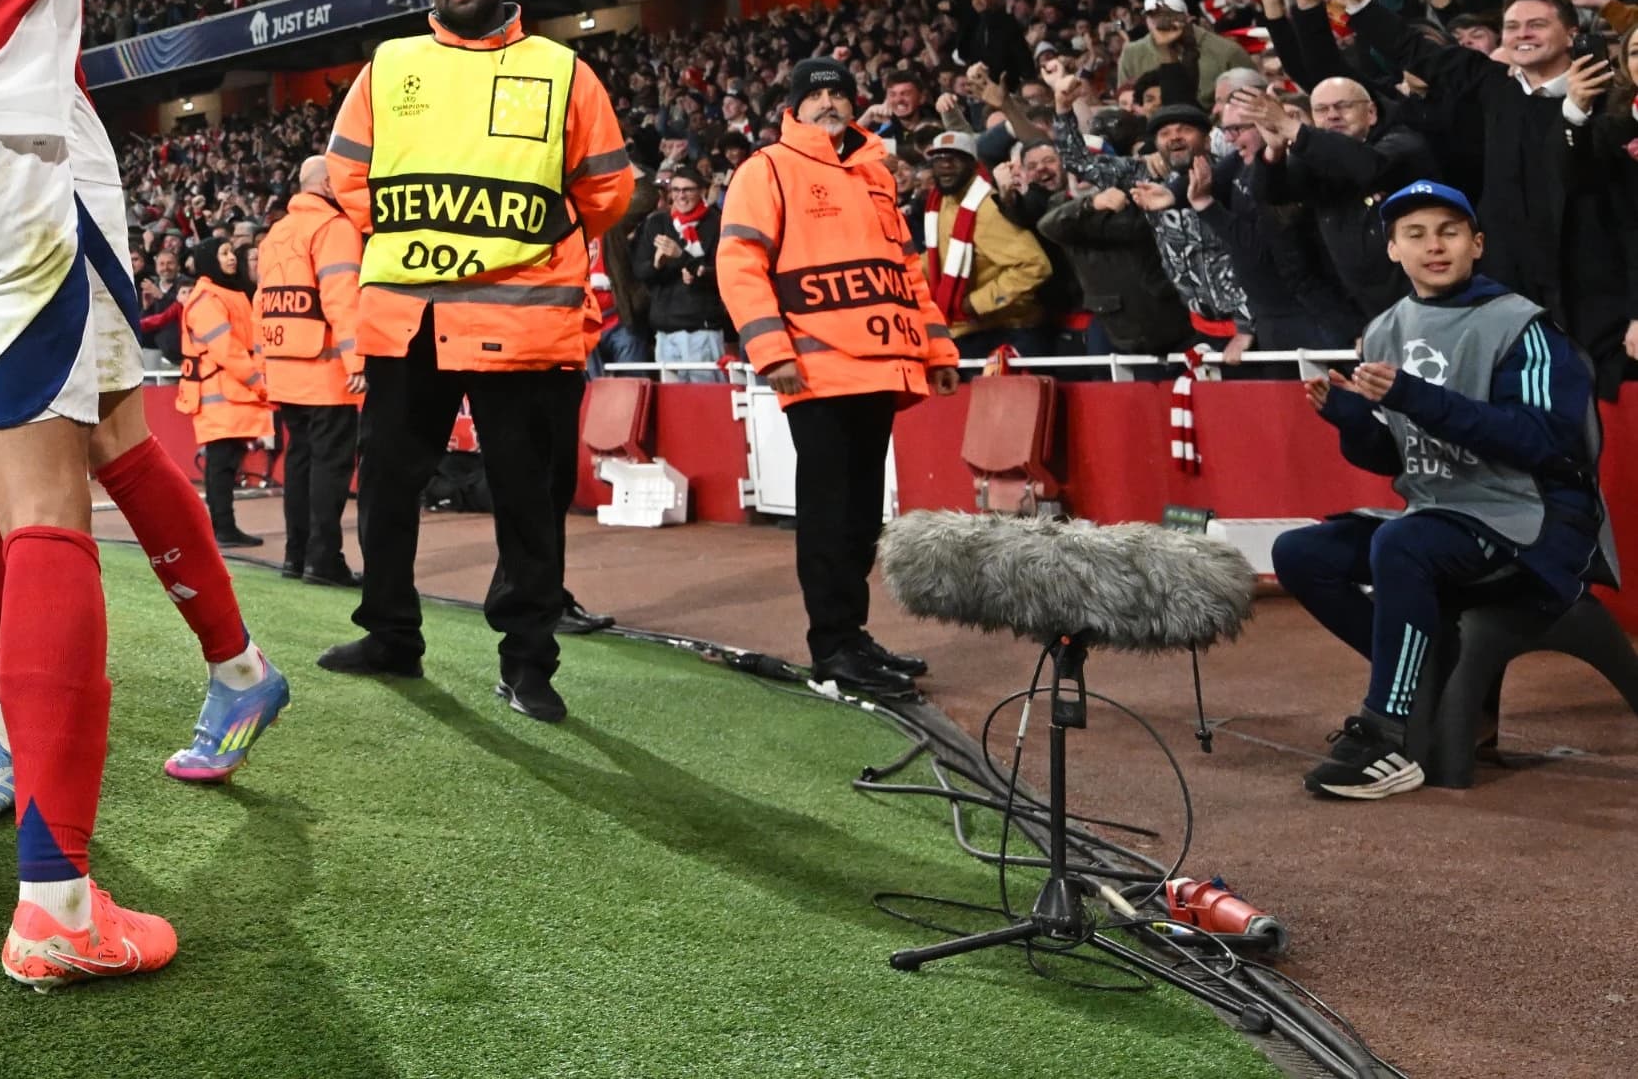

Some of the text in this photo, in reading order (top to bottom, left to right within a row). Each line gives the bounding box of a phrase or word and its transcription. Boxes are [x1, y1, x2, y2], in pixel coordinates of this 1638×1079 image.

[272, 3, 332, 39] JUST EAT
[375, 184, 547, 234] STEWARD
[402, 240, 485, 277] 096
[866, 313, 922, 347] 996
